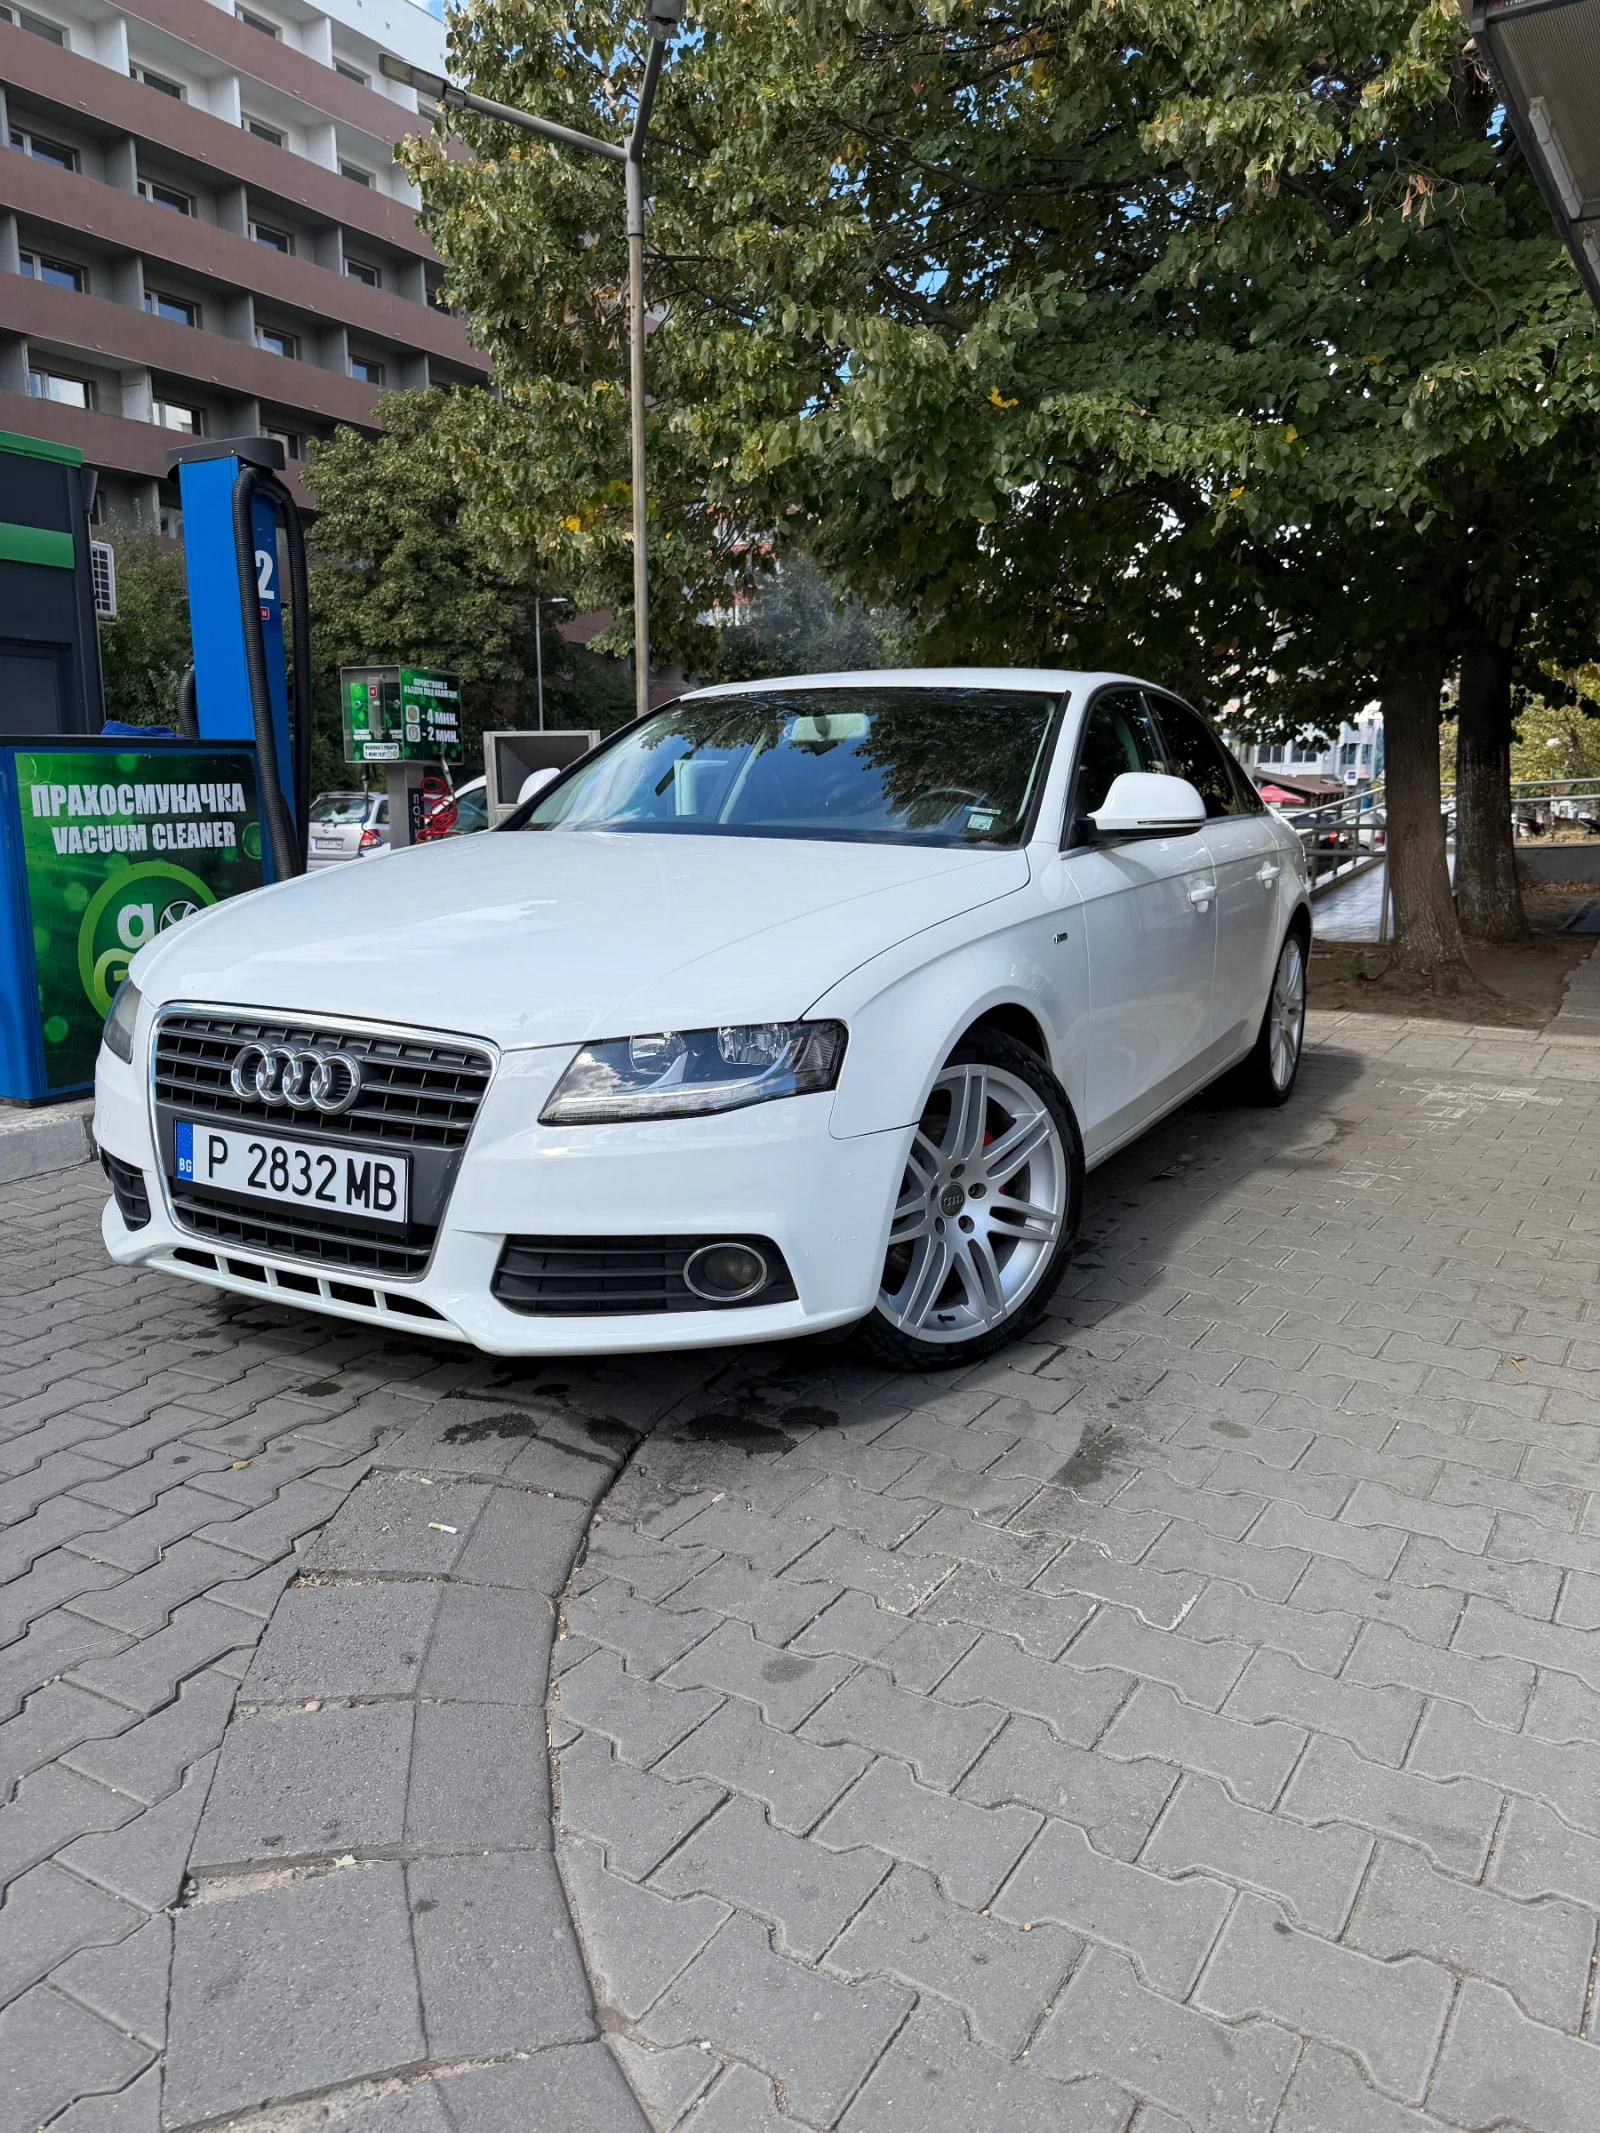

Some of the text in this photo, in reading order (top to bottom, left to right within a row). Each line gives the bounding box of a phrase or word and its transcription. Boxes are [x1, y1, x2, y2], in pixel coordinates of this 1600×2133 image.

[254, 550, 275, 600] 2
[426, 709, 434, 724] 4
[435, 712, 458, 725] МИН.
[427, 727, 434, 741] 2
[436, 729, 459, 743] МИН.
[30, 783, 246, 817] ПРАХОСМУКАЧКА
[52, 822, 236, 854] VACUUM CLEANER
[179, 1158, 192, 1172] BG
[208, 1134, 396, 1211] P 2832 MB
